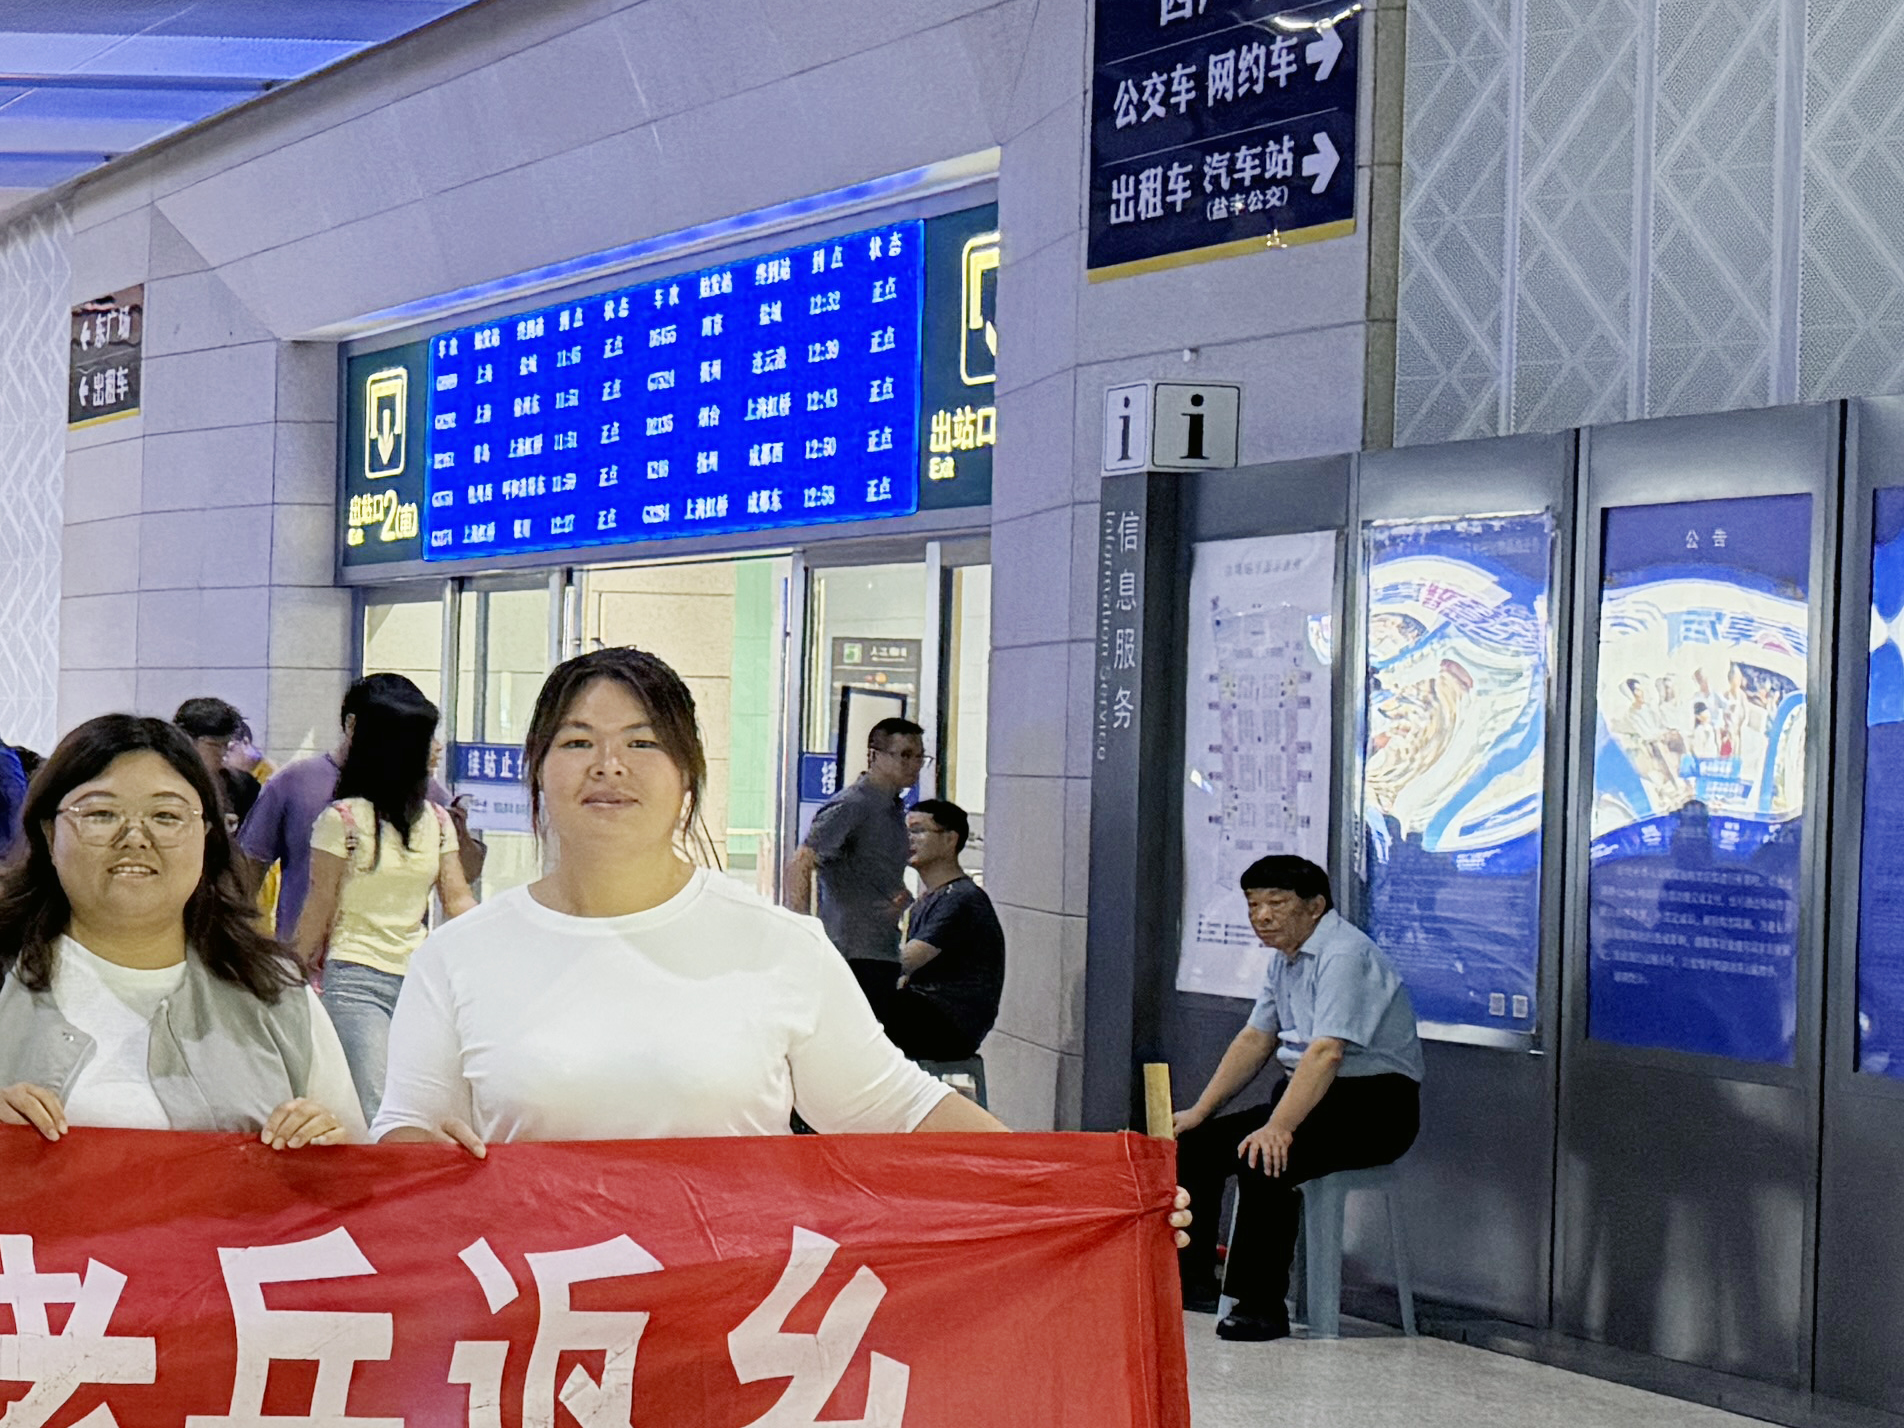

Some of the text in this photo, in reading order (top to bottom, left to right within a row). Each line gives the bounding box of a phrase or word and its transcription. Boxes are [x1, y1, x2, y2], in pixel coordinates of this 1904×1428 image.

[1113, 35, 1298, 130] 公交车 网约车
[1110, 135, 1295, 225] 出租车 汽车站
[929, 404, 997, 453] 出站口
[1100, 510, 1117, 658] Information
[1685, 527, 1729, 550] 公告
[1113, 510, 1141, 730] 信息服务
